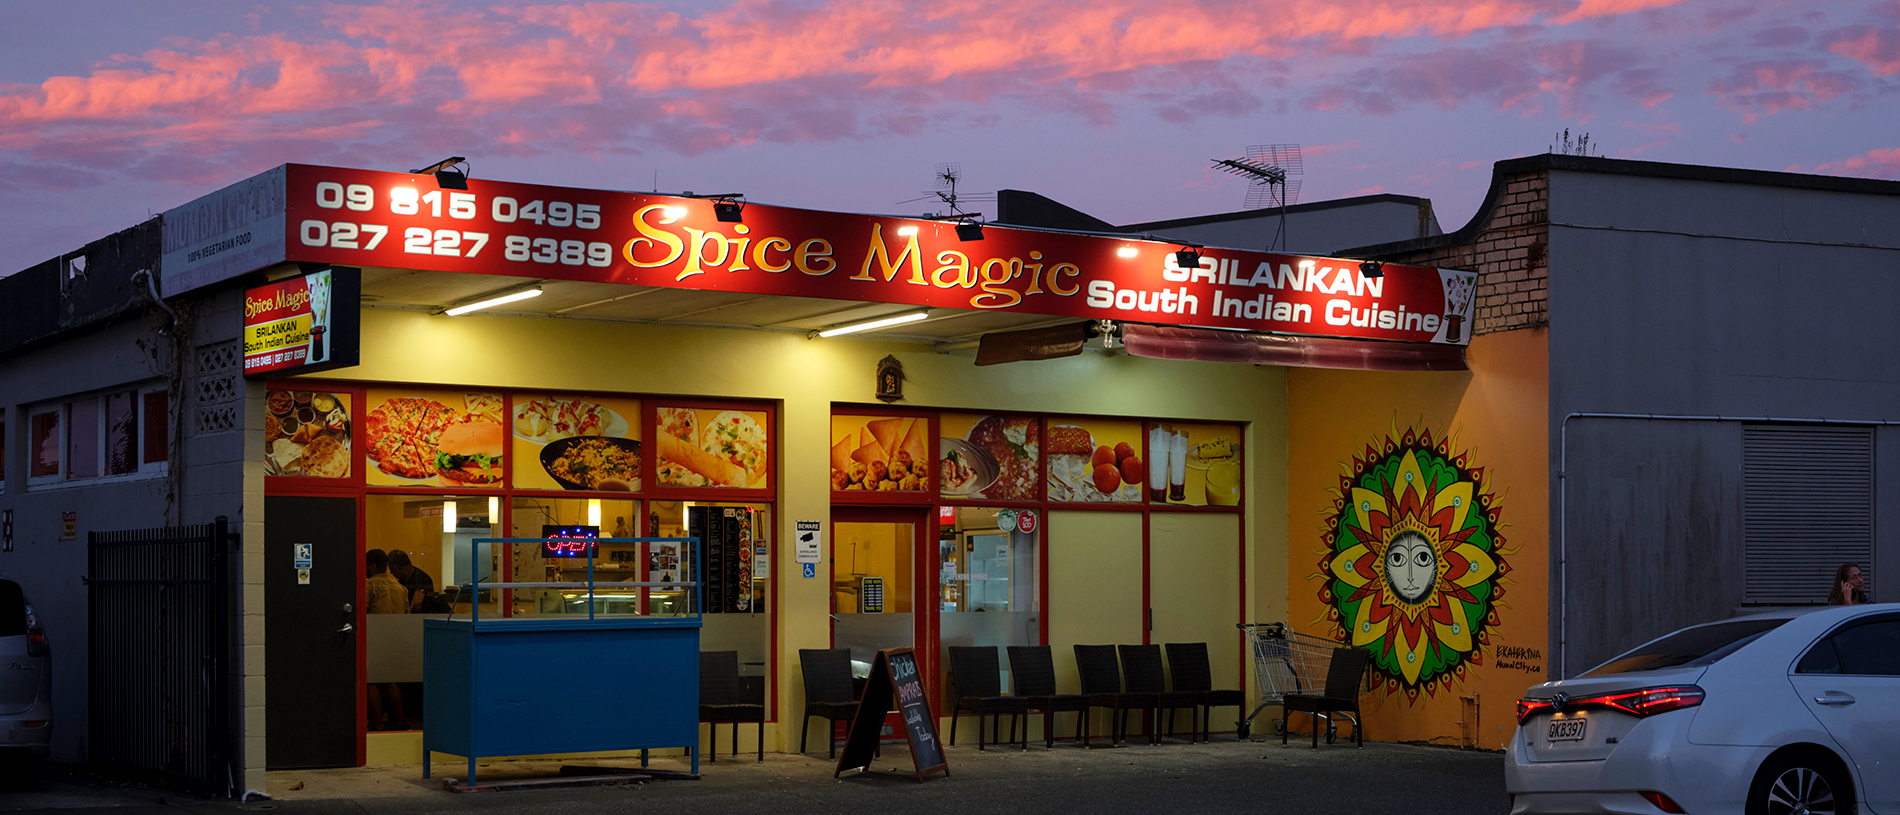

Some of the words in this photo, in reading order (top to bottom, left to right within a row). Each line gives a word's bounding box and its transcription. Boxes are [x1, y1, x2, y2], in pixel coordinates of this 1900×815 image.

[315, 181, 374, 212] 09
[389, 186, 477, 221] 815
[492, 196, 602, 231] 0495
[202, 237, 235, 258] VEGETARIAN
[235, 232, 252, 247] FOOD
[300, 219, 389, 251] 027
[403, 226, 489, 258] 227
[504, 235, 613, 268] 8389
[622, 203, 837, 281] Spice
[849, 222, 1080, 309] Magic
[1162, 252, 1383, 298] SRILANKAN
[245, 297, 273, 319] Spice
[274, 288, 310, 312] Magic
[1086, 279, 1199, 316] South
[1212, 289, 1312, 324] Indian
[1324, 298, 1441, 334] Cuisine
[244, 339, 263, 353] South
[265, 337, 284, 349] Indian
[285, 332, 310, 345] Cuisine
[256, 320, 298, 338] SRILANKAN
[1496, 645, 1542, 660] EKATERINA
[1549, 722, 1584, 738] QKB397
